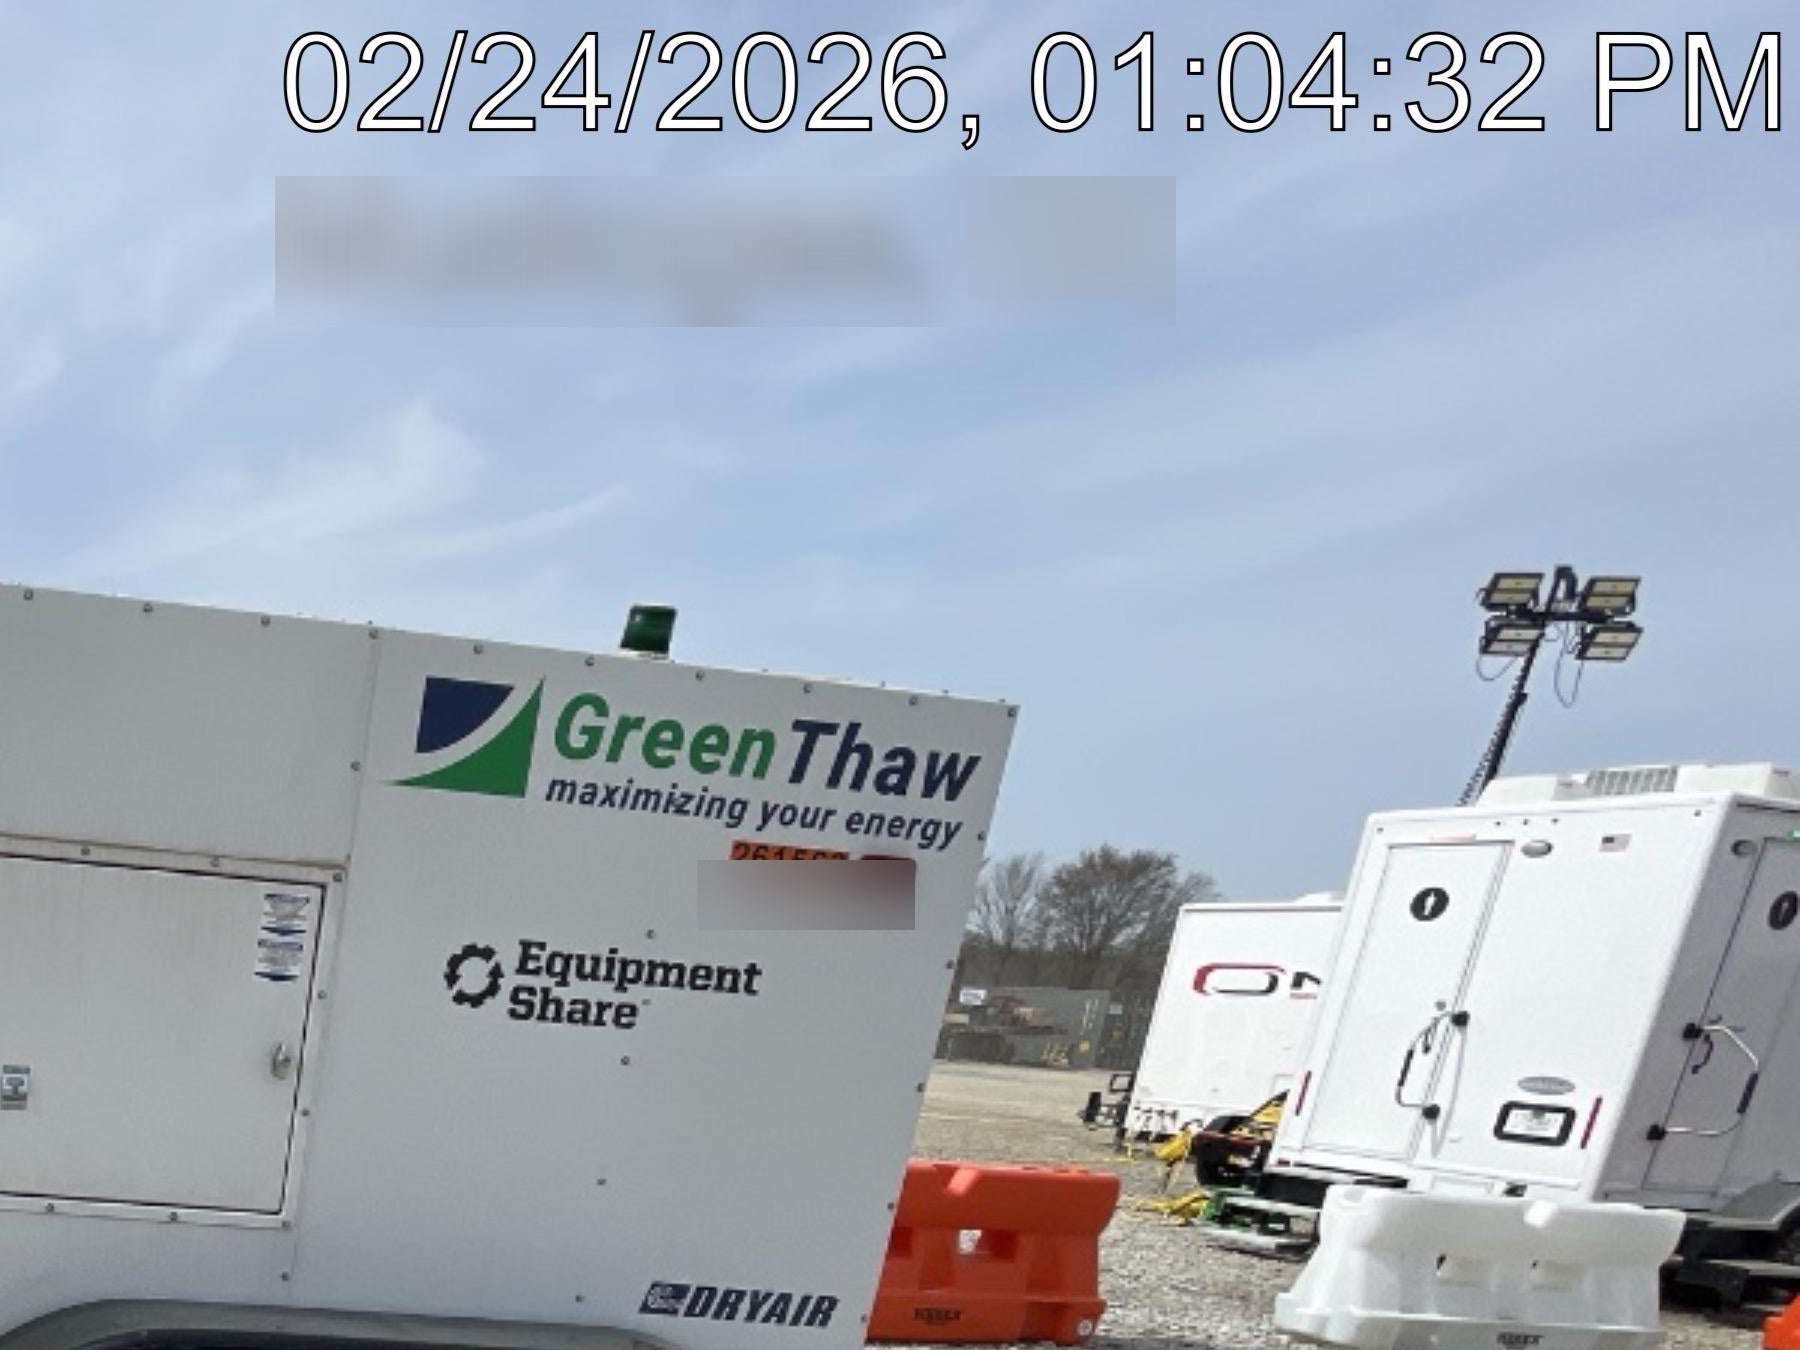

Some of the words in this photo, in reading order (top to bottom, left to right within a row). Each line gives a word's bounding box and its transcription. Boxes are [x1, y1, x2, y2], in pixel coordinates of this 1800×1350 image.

[545, 777, 750, 829] maximizing
[756, 799, 838, 834] your
[845, 811, 964, 852] energy
[515, 939, 763, 996] Equipment
[507, 985, 638, 1029] Share
[683, 1286, 840, 1328] DRYAIR
